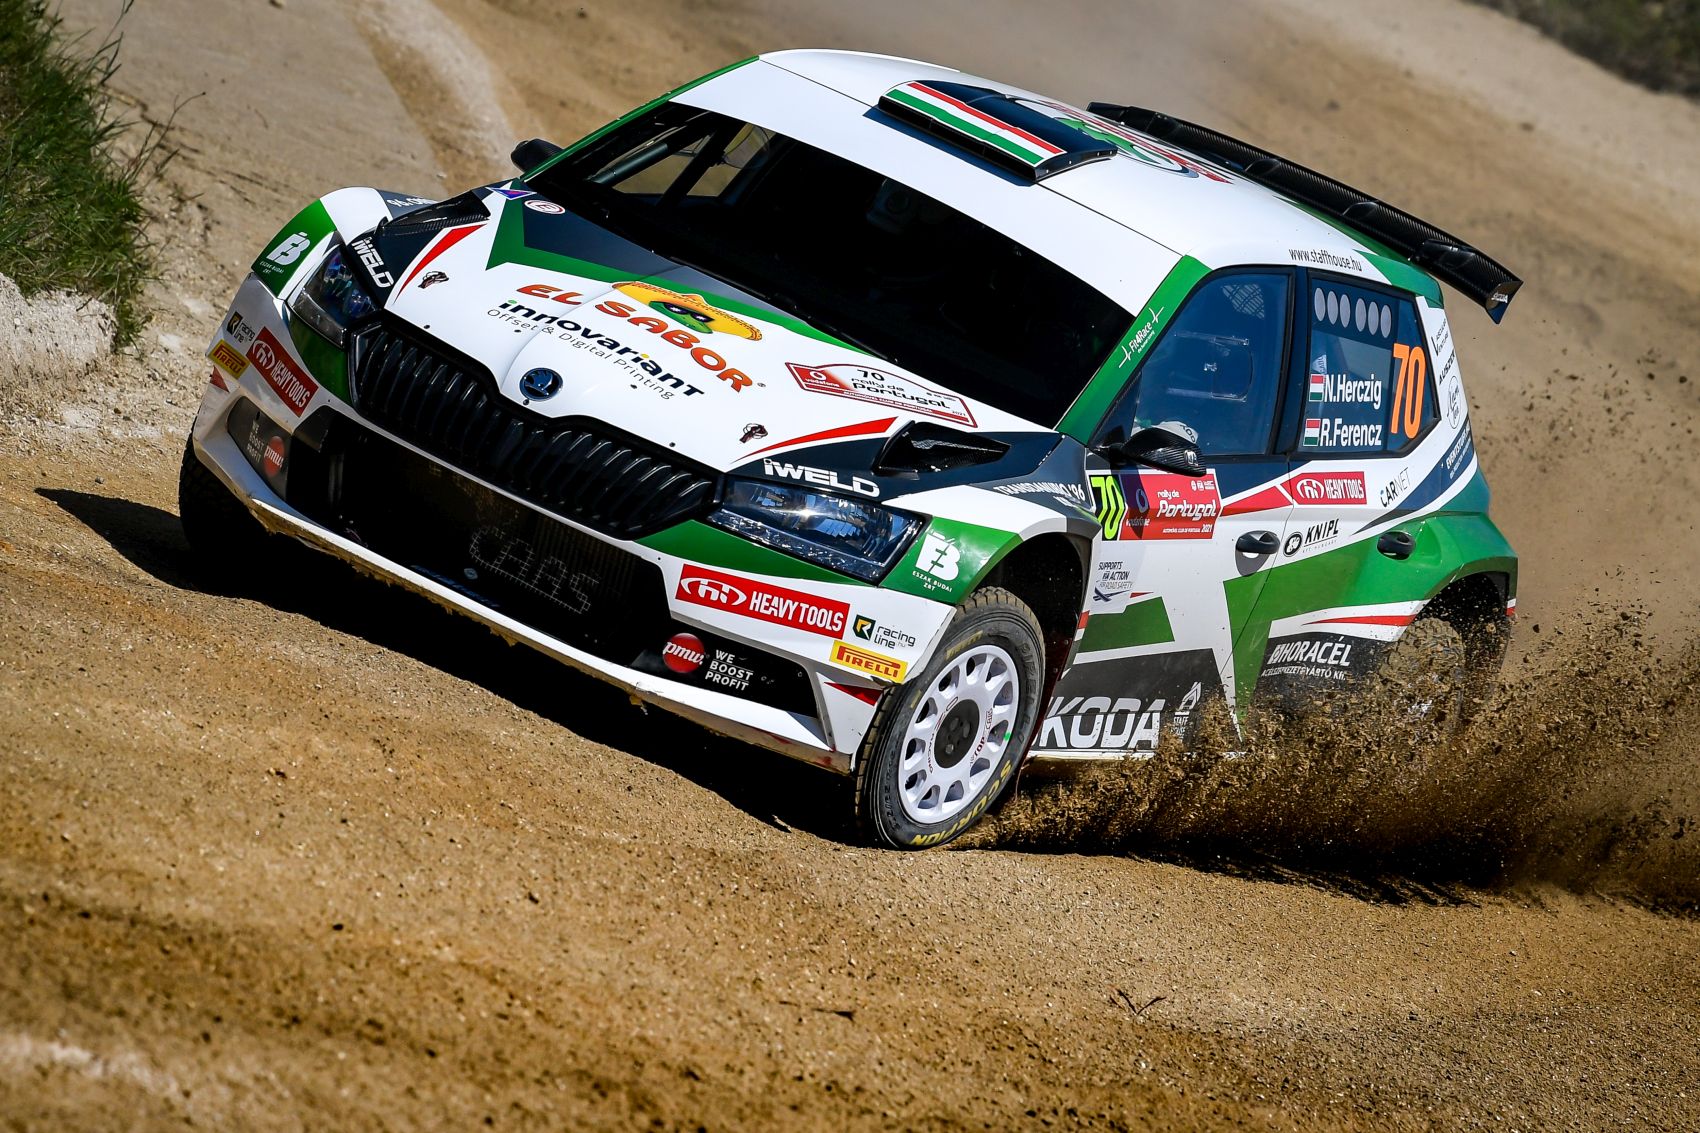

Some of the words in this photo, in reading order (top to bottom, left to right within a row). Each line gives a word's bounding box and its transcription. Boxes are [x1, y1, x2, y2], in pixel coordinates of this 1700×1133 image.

[1289, 249, 1363, 271] www.staffhouse.hu
[516, 284, 583, 306] EL
[594, 300, 753, 393] SABOR
[214, 344, 246, 374] PIRELLI
[487, 309, 536, 331] Offset
[541, 326, 555, 335] &
[558, 332, 612, 361] Digital
[612, 357, 675, 400] Printing
[851, 378, 885, 389] rally
[857, 369, 886, 382] 70
[1324, 374, 1382, 409] N.Herczig
[1391, 343, 1426, 439] 70
[1320, 418, 1382, 446] R.Ferencz
[1157, 490, 1172, 499] rally
[1172, 490, 1180, 498] de
[1380, 467, 1409, 507] CARNET
[1090, 476, 1124, 539] 70
[1156, 500, 1217, 521] Portugal
[1304, 518, 1340, 544] KNIPL
[1098, 561, 1123, 571] SUPPORTS
[1109, 571, 1130, 580] ACTION
[874, 633, 896, 649] line
[876, 626, 916, 647] racing
[715, 649, 735, 664] WE
[837, 645, 901, 678] PIRELLI
[704, 671, 750, 691] PROFIT
[709, 660, 754, 681] BOOST
[1032, 696, 1166, 748] KODA
[911, 759, 1012, 847] SCORPION
